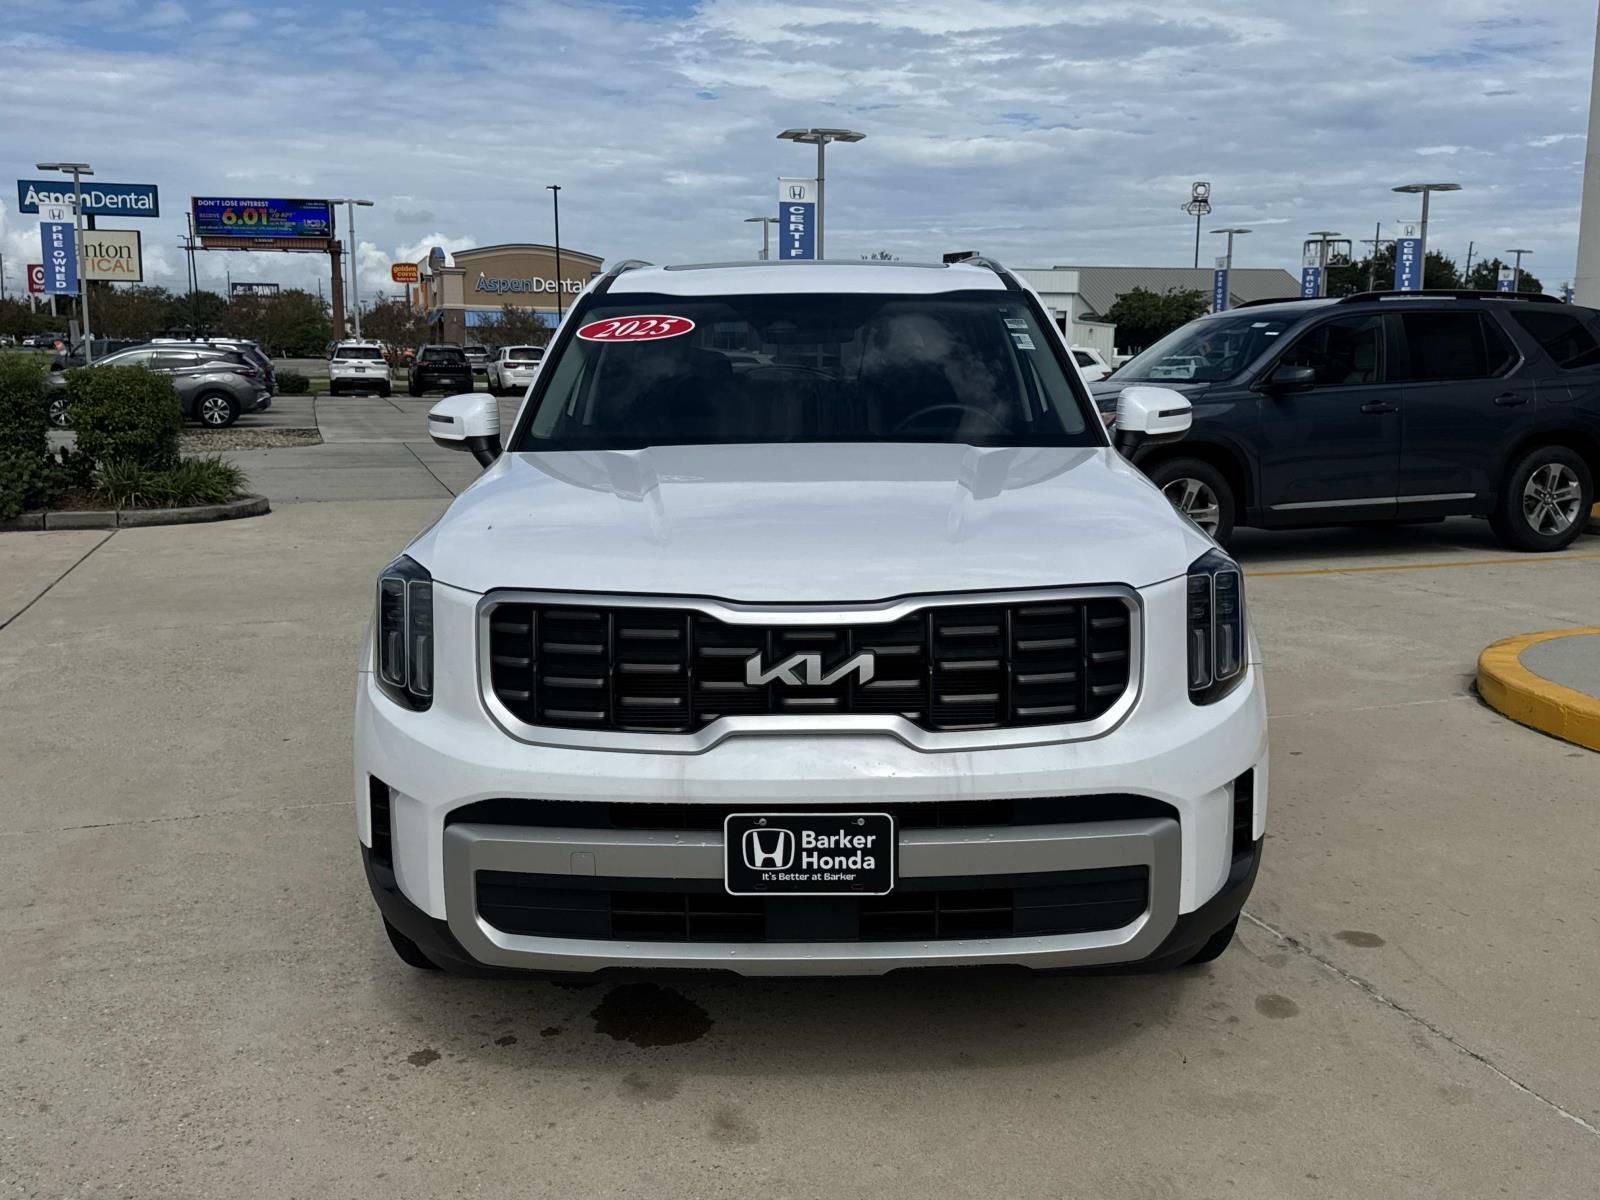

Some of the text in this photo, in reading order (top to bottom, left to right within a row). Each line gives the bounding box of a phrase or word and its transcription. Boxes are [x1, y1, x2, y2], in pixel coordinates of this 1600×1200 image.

[222, 207, 267, 225] 6.01
[75, 241, 132, 258] nton
[593, 319, 678, 338] 2025
[746, 653, 875, 686] KIA
[801, 829, 876, 849] Barker
[801, 850, 876, 870] Honda
[762, 872, 856, 881] It's Better at Barker
